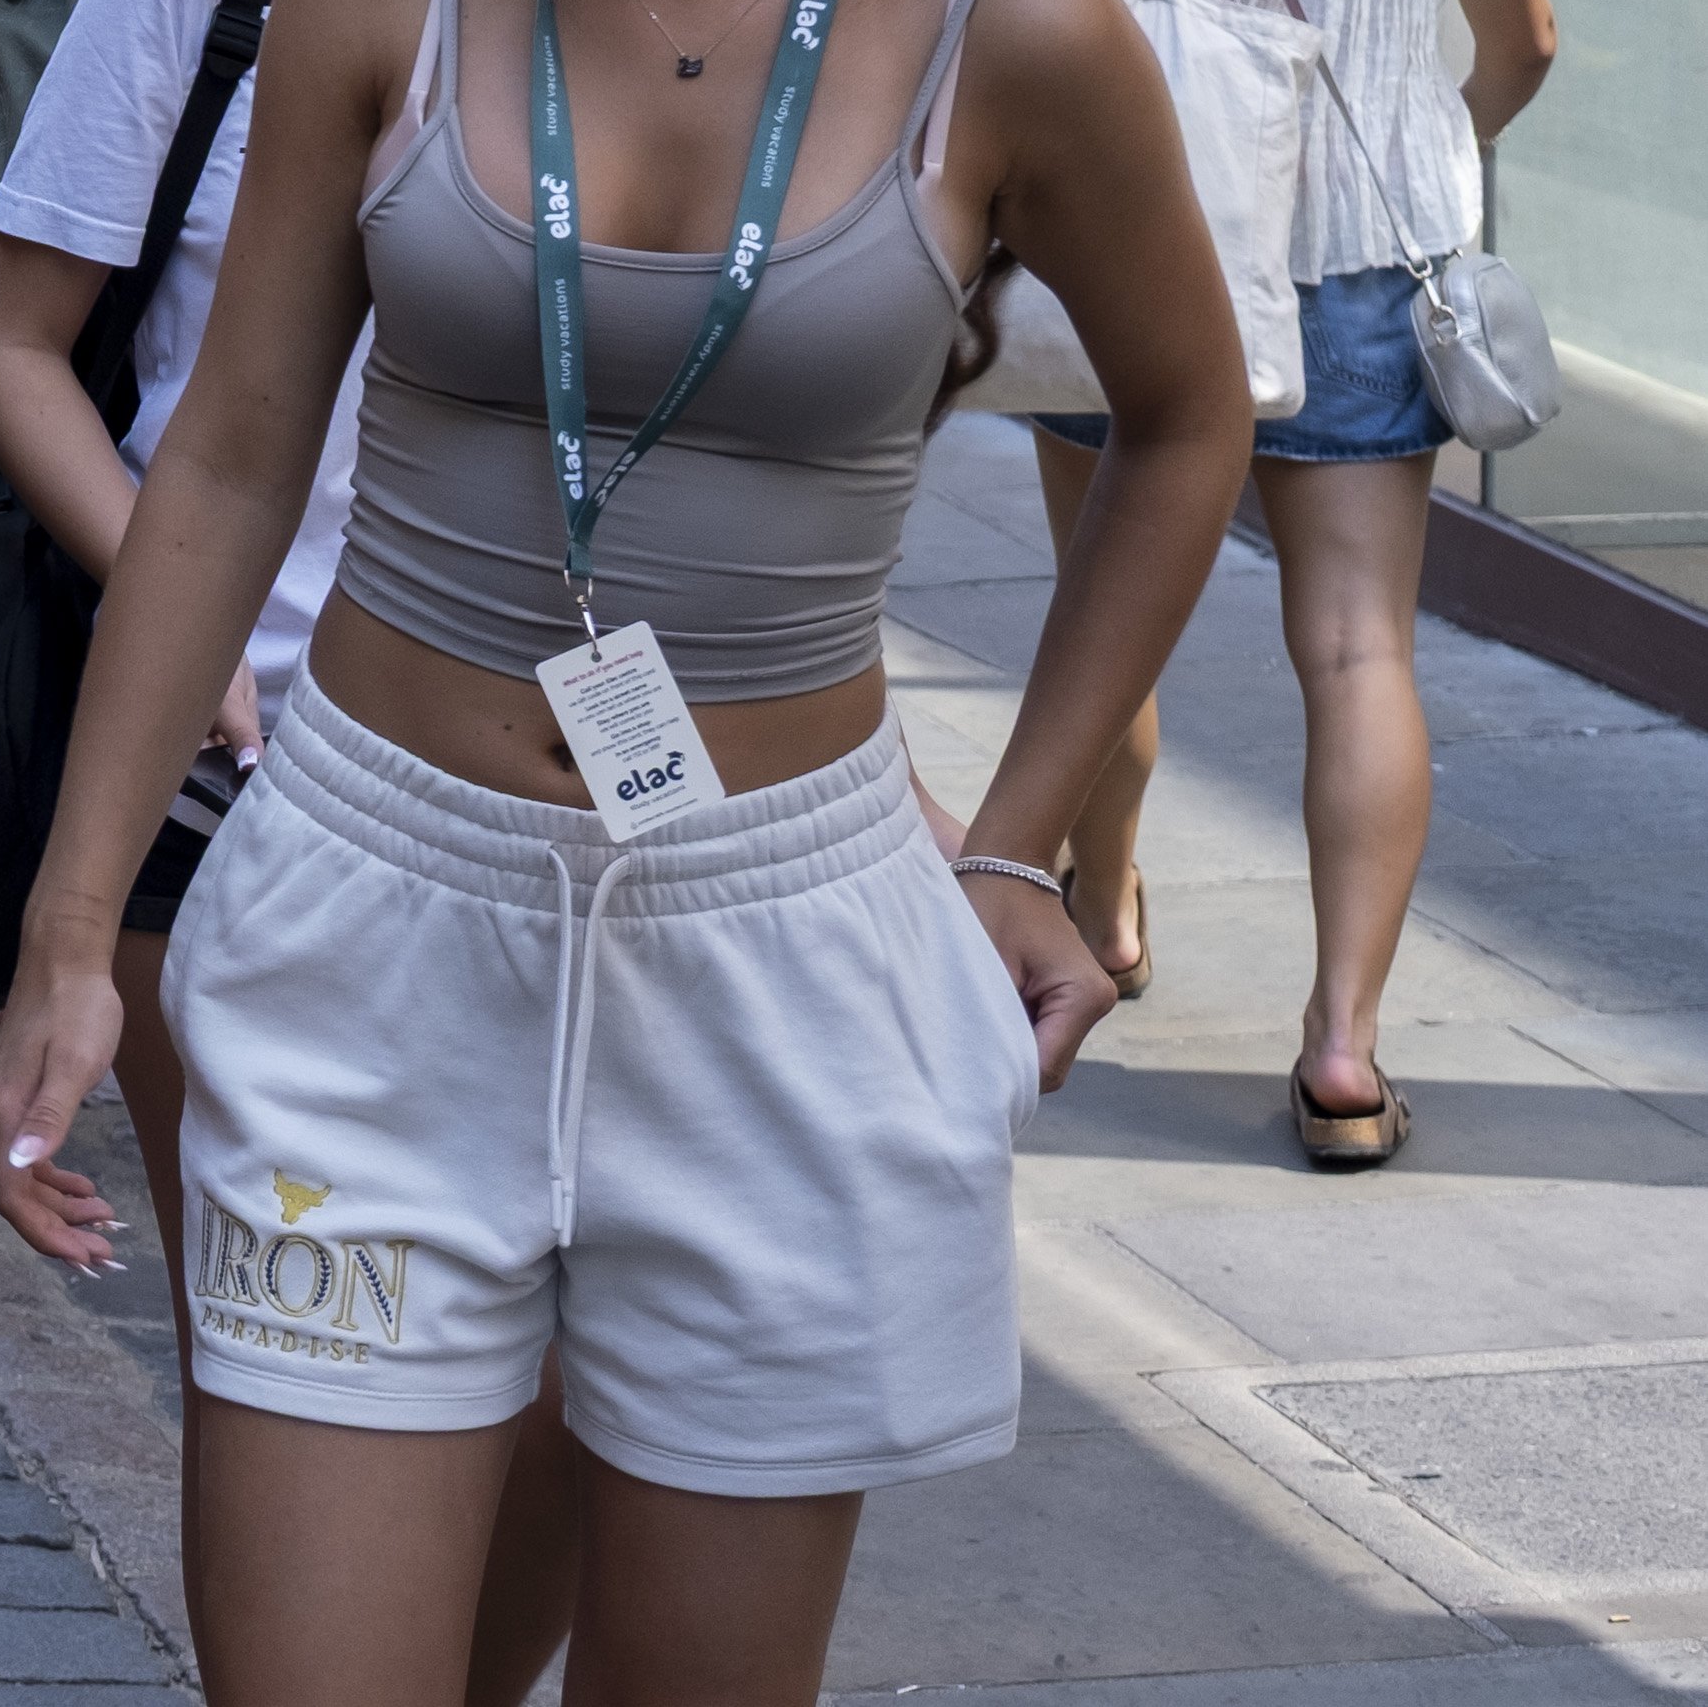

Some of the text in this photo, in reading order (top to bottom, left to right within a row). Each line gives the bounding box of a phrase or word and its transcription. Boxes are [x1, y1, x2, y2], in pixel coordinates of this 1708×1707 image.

[761, 86, 795, 188] study vacations
[540, 172, 571, 239] elac
[729, 222, 763, 291] elac
[555, 278, 572, 390] study vacations
[557, 430, 583, 500] elac
[595, 451, 636, 507] elac
[616, 755, 685, 802] elac
